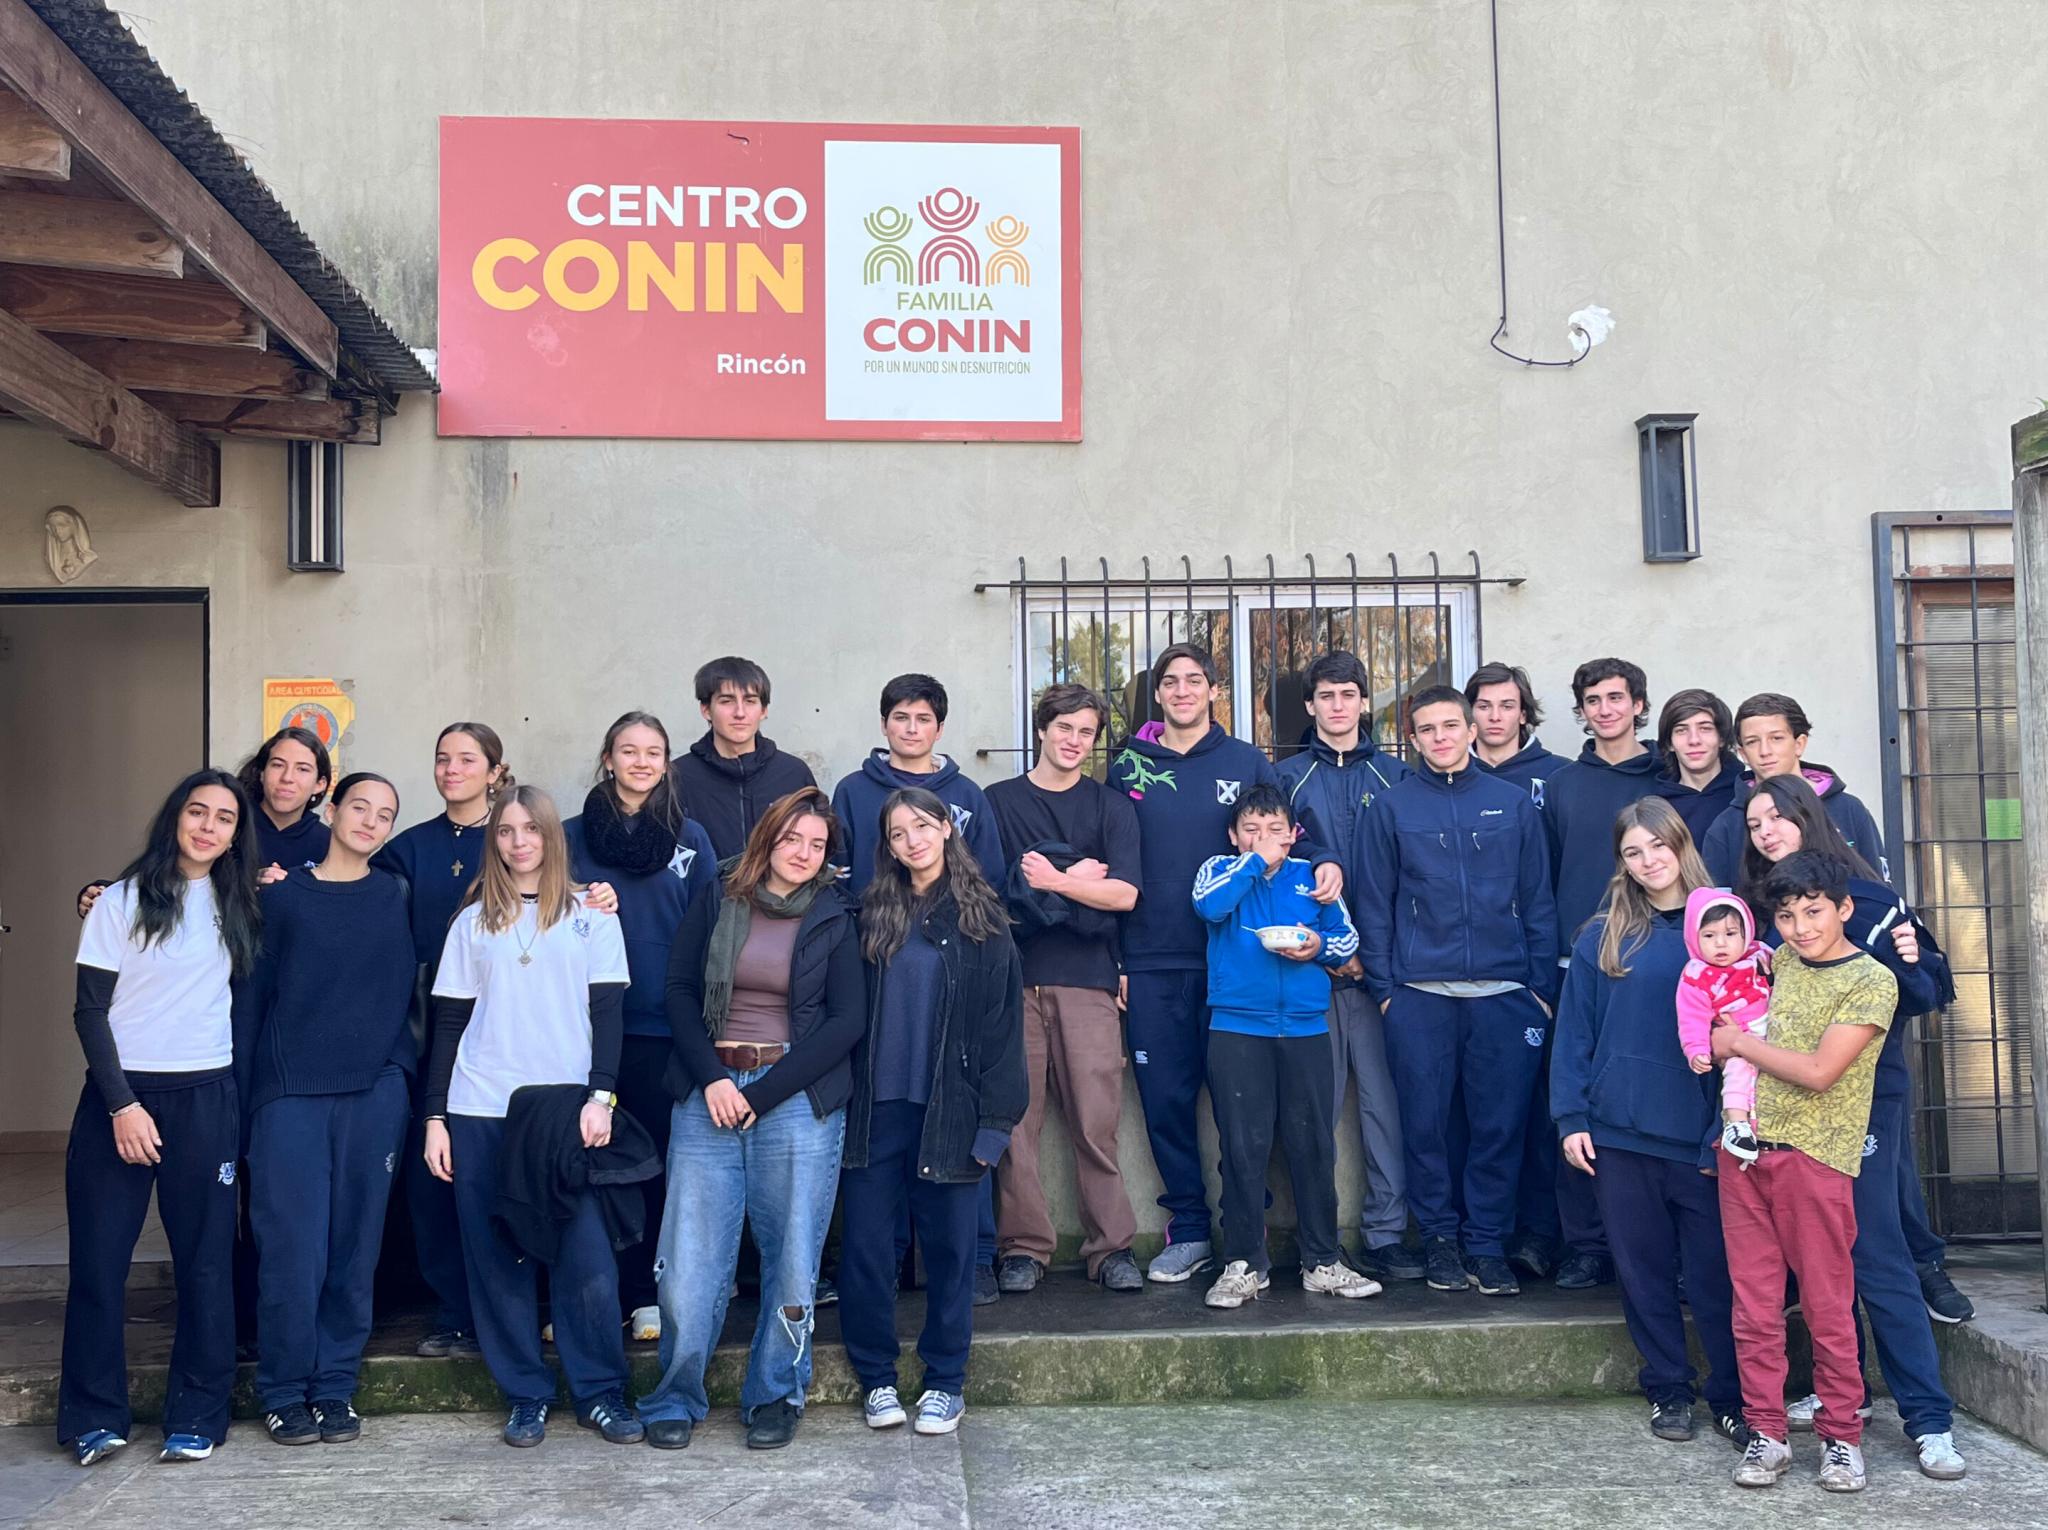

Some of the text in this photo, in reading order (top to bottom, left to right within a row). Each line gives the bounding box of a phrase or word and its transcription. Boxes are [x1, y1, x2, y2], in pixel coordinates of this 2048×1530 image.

[568, 183, 807, 229] CENTRO
[472, 238, 804, 314] CONIN
[897, 291, 994, 311] FAMILIA
[863, 317, 1031, 353] CONIN
[717, 352, 806, 375] Rincón
[864, 359, 1031, 374] POR UN MUNDO SIN DESNUTRICIÓN
